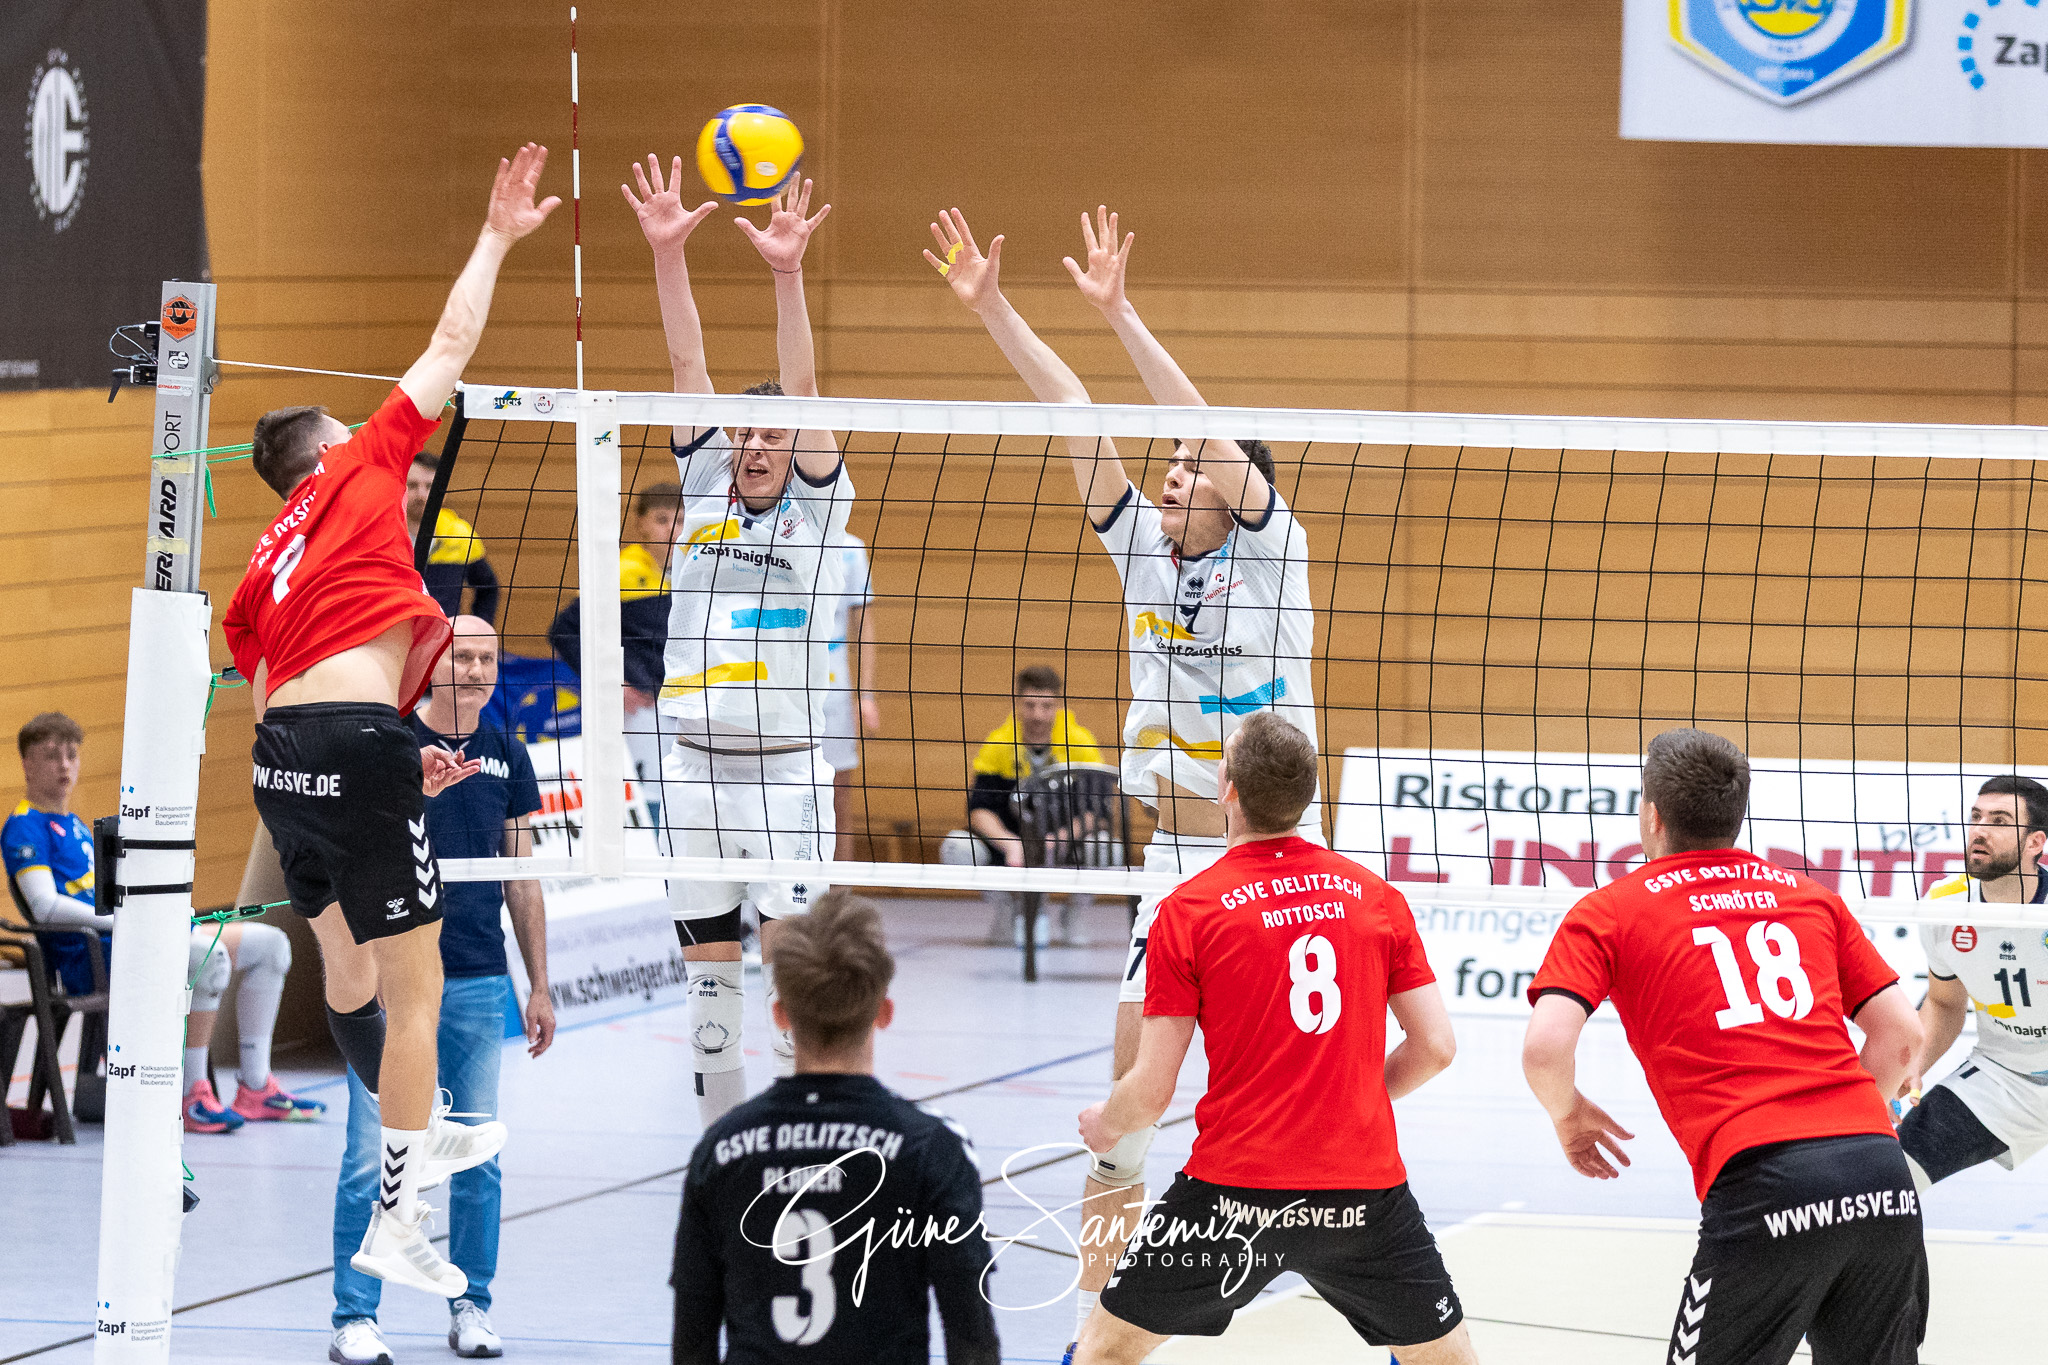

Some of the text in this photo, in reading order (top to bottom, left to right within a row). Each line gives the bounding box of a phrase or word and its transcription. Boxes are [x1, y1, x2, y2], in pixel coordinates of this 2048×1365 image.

[1995, 35, 2048, 74] Za
[163, 410, 182, 461] PORT
[733, 548, 793, 571] Daigfuss
[480, 756, 509, 779] MM
[122, 804, 151, 820] Zapf
[1878, 810, 1951, 855] bei
[1220, 873, 1363, 910] GSVE DELITZSCH
[1644, 868, 1697, 893] GSVE
[1261, 901, 1346, 929] ROTTOSCH
[1688, 889, 1779, 912] SCHRÖTER
[1411, 904, 1563, 945] ehringer
[1288, 933, 1342, 1035] 8
[1691, 920, 1815, 1031] 18
[1993, 967, 2032, 1008] 11
[108, 1062, 137, 1079] Zapf
[715, 1122, 904, 1165] GSVE DELITZSCH
[1217, 1194, 1367, 1231] WWW.GSVE.DE
[1763, 1189, 1919, 1239] WWW.GSVE.DE
[770, 1207, 838, 1346] 3
[97, 1319, 127, 1336] Zapf
